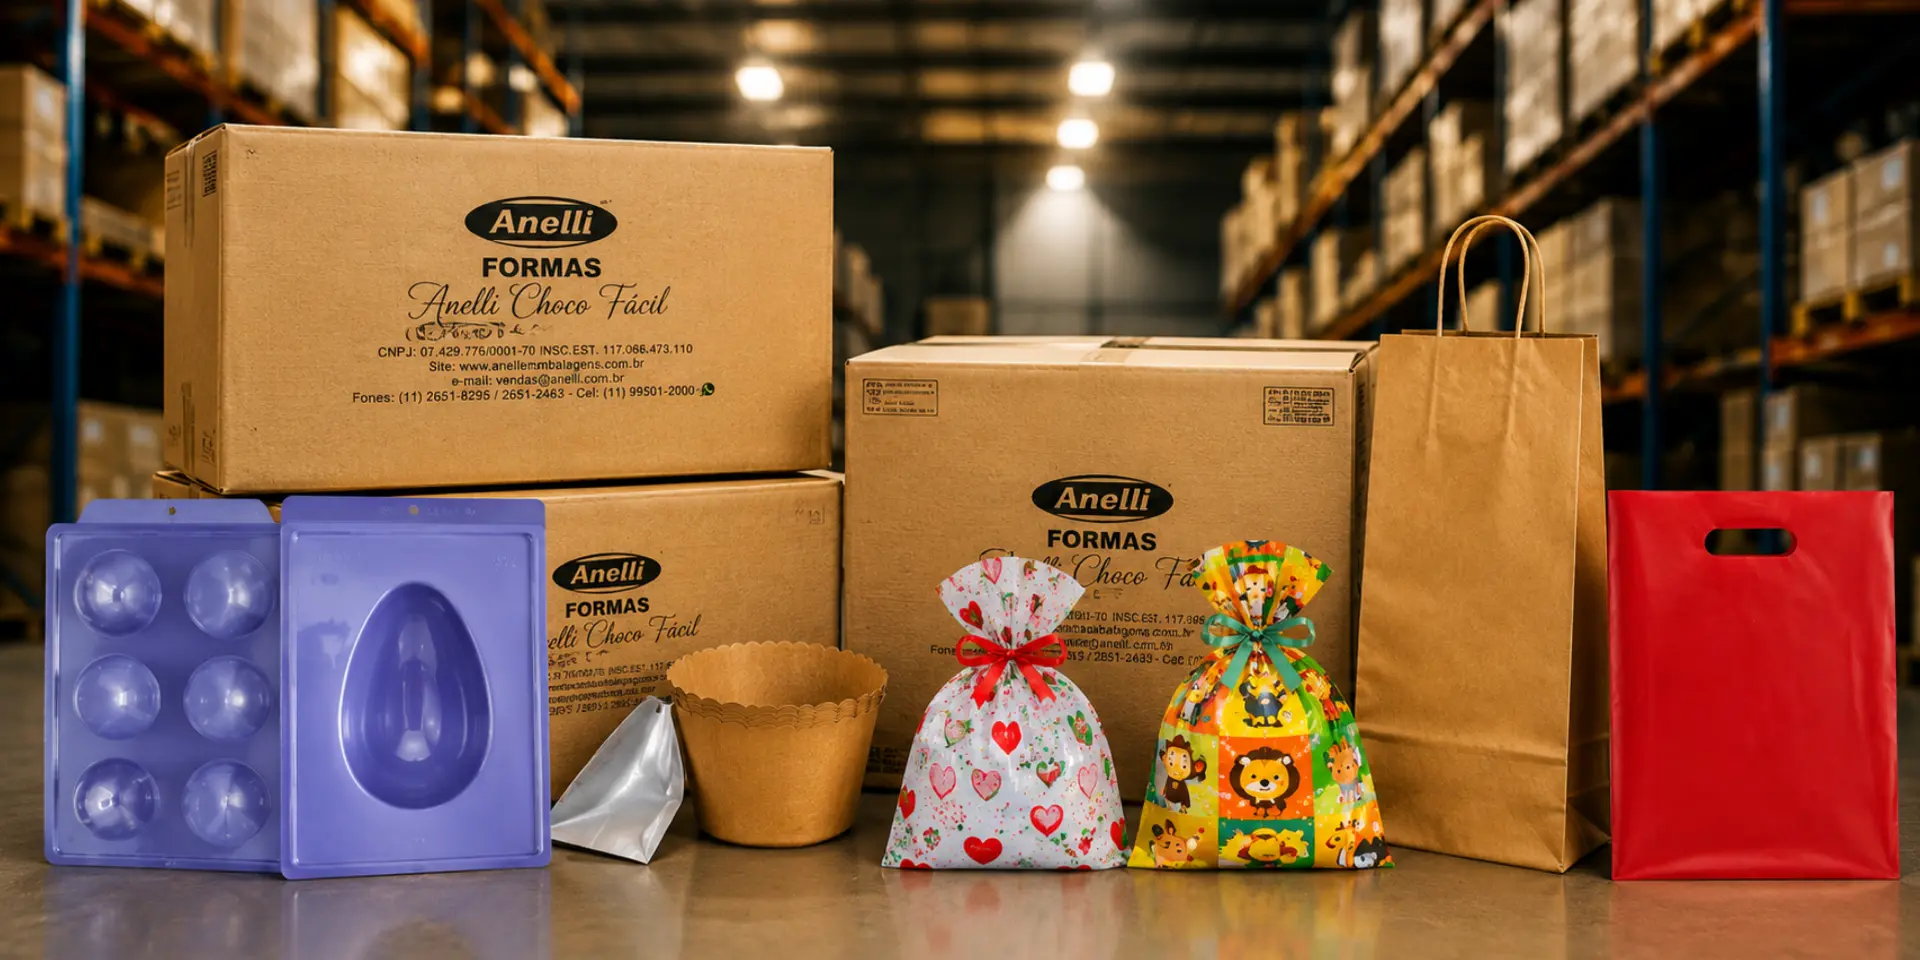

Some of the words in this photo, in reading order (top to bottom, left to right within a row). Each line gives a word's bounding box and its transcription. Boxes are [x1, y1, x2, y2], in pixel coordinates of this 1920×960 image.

[489, 209, 594, 235] Anelli
[482, 257, 601, 278] FORMAS
[408, 281, 500, 322] Anelli
[509, 283, 591, 319] Choco
[599, 283, 671, 320] Fácil
[378, 346, 417, 358] CNPJ:
[420, 345, 536, 357] 07.429.776/0001-70
[539, 344, 600, 356] INSC.EST.
[429, 360, 456, 372] Site:
[451, 374, 492, 387] e-mail:
[352, 391, 395, 404] Fones:
[399, 390, 422, 405] (11)
[426, 389, 490, 402] 2651-8295
[502, 388, 565, 401] 2651-2463
[576, 386, 600, 399] Cel:
[603, 386, 626, 400] (11)
[1054, 486, 1152, 511] Anelli
[1047, 528, 1157, 551] FORMAS
[570, 560, 645, 585] Anelli
[1071, 553, 1148, 588] Choco
[565, 597, 650, 618] FORMAS
[547, 624, 578, 650] elli
[583, 618, 644, 649] Choco
[648, 613, 702, 644] Fácil
